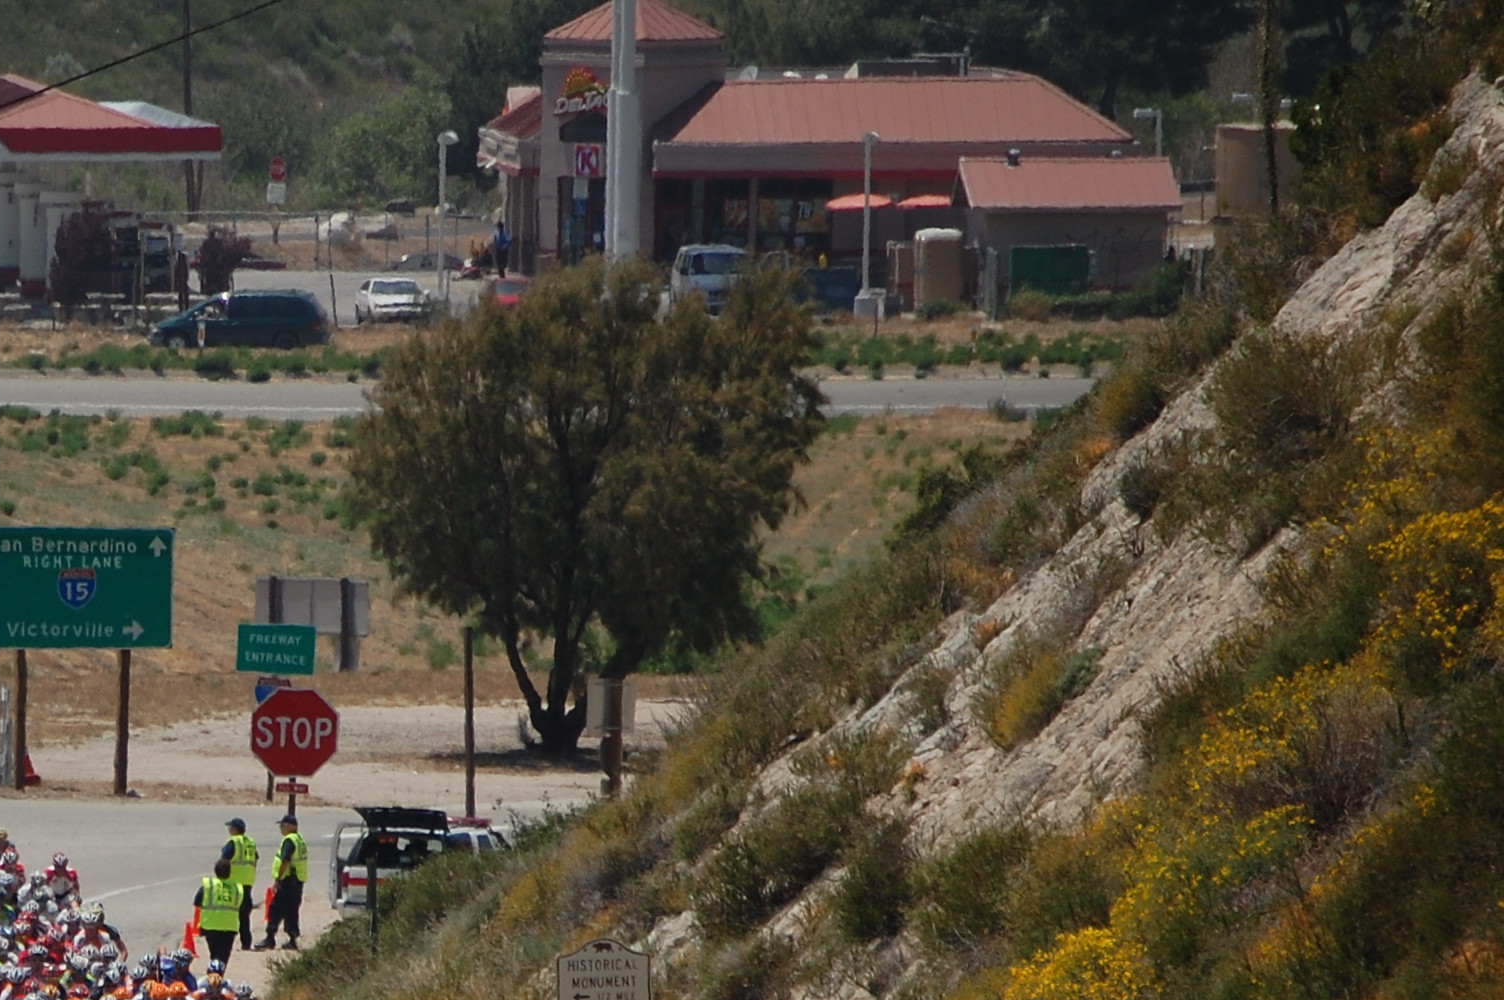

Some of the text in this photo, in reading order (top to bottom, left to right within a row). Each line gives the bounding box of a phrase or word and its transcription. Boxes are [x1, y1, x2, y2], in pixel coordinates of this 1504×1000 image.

[576, 147, 598, 176] K
[31, 537, 137, 554] Bernardino
[23, 556, 123, 569] RIGHT LANE
[65, 582, 89, 601] 15
[7, 622, 114, 638] Victorville
[249, 633, 303, 646] FREEWAY
[245, 651, 307, 666] ENTRANCE
[255, 716, 333, 750] STOP
[567, 959, 639, 972] HISTORICAL
[571, 976, 636, 989] MONUMENT
[616, 991, 636, 1000] MILE
